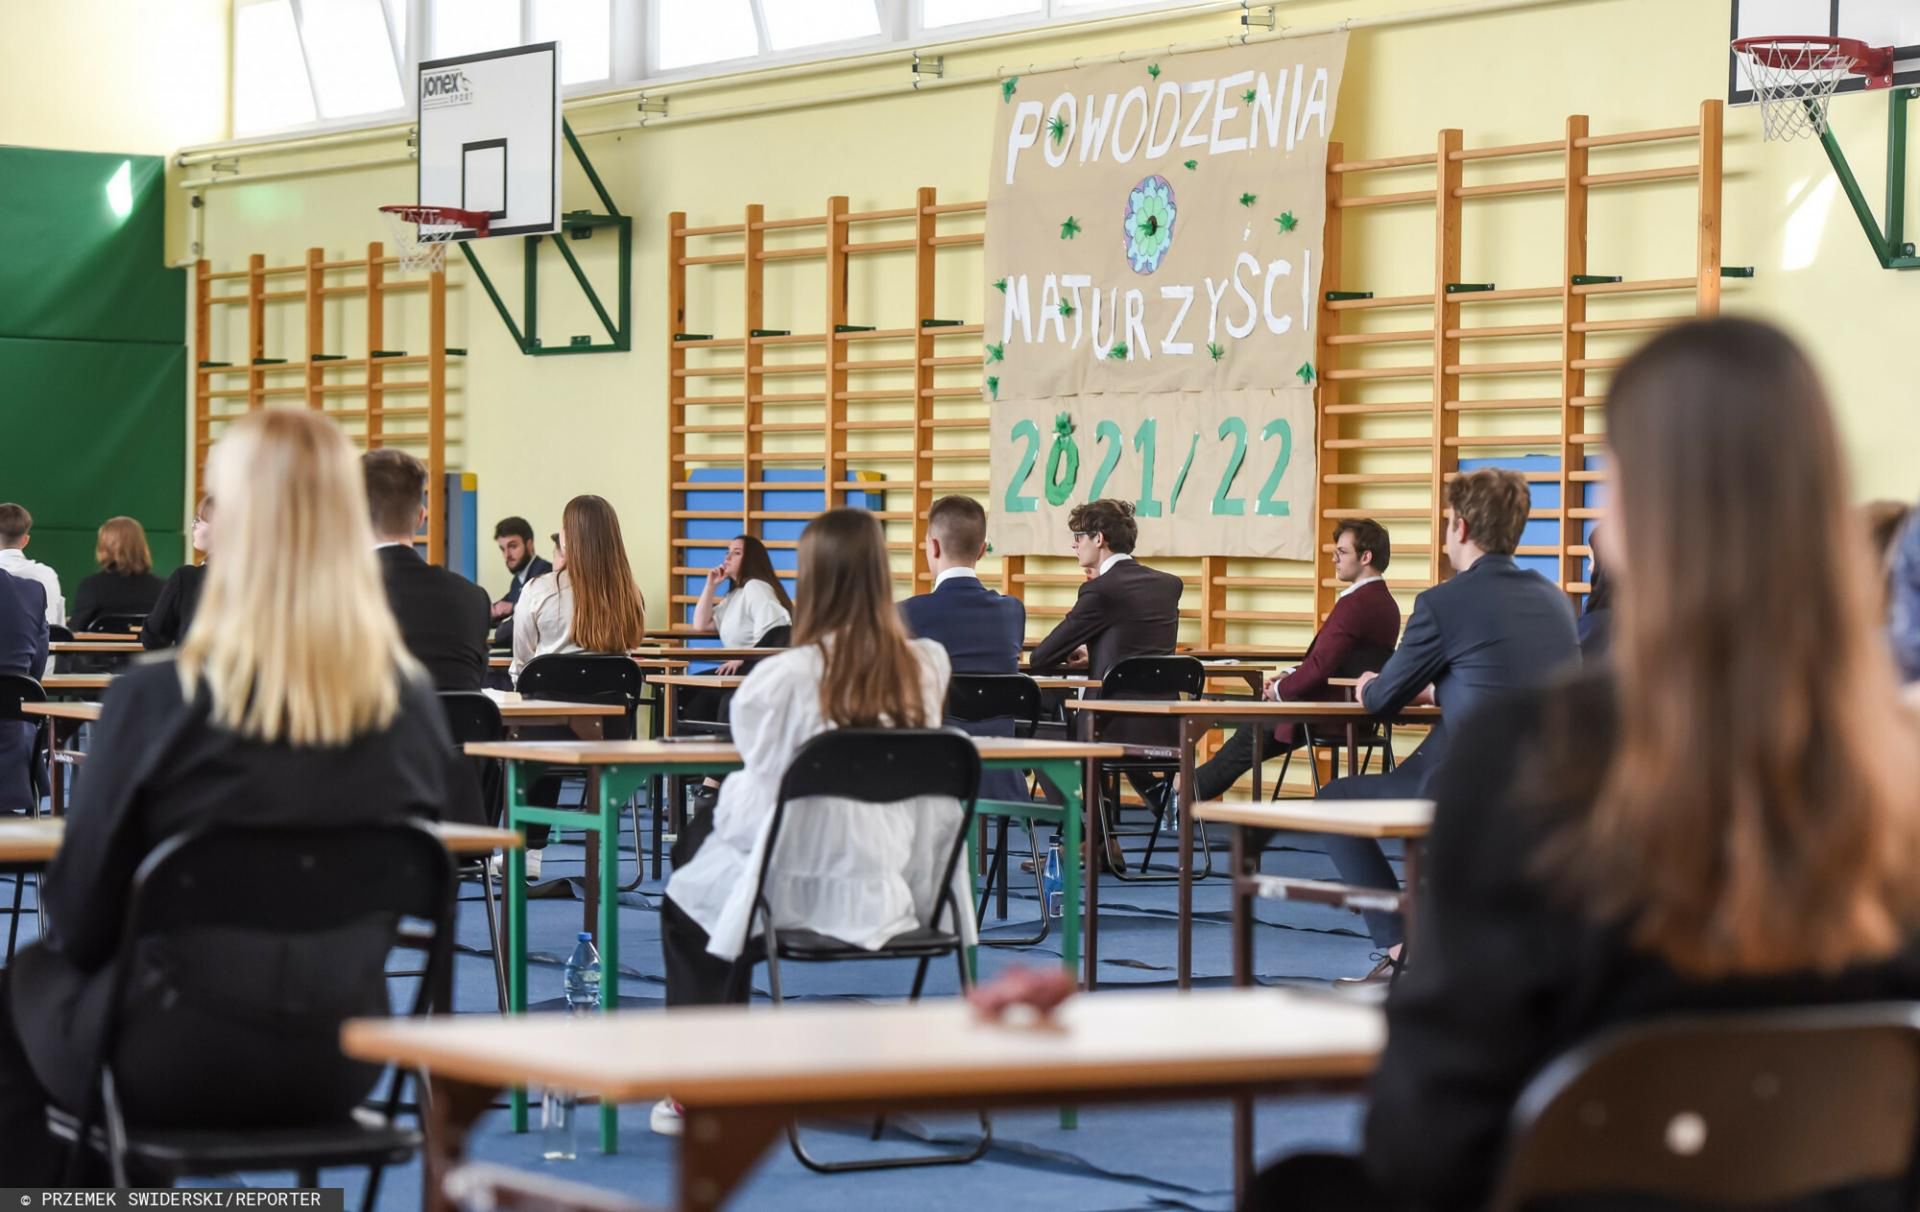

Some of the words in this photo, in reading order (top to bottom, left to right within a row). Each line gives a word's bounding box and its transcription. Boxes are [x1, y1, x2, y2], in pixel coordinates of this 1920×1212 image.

[1006, 64, 1328, 185] POWODZENIA
[1003, 225, 1311, 361] MATURZYŚCI
[1004, 416, 1292, 518] 2021/22
